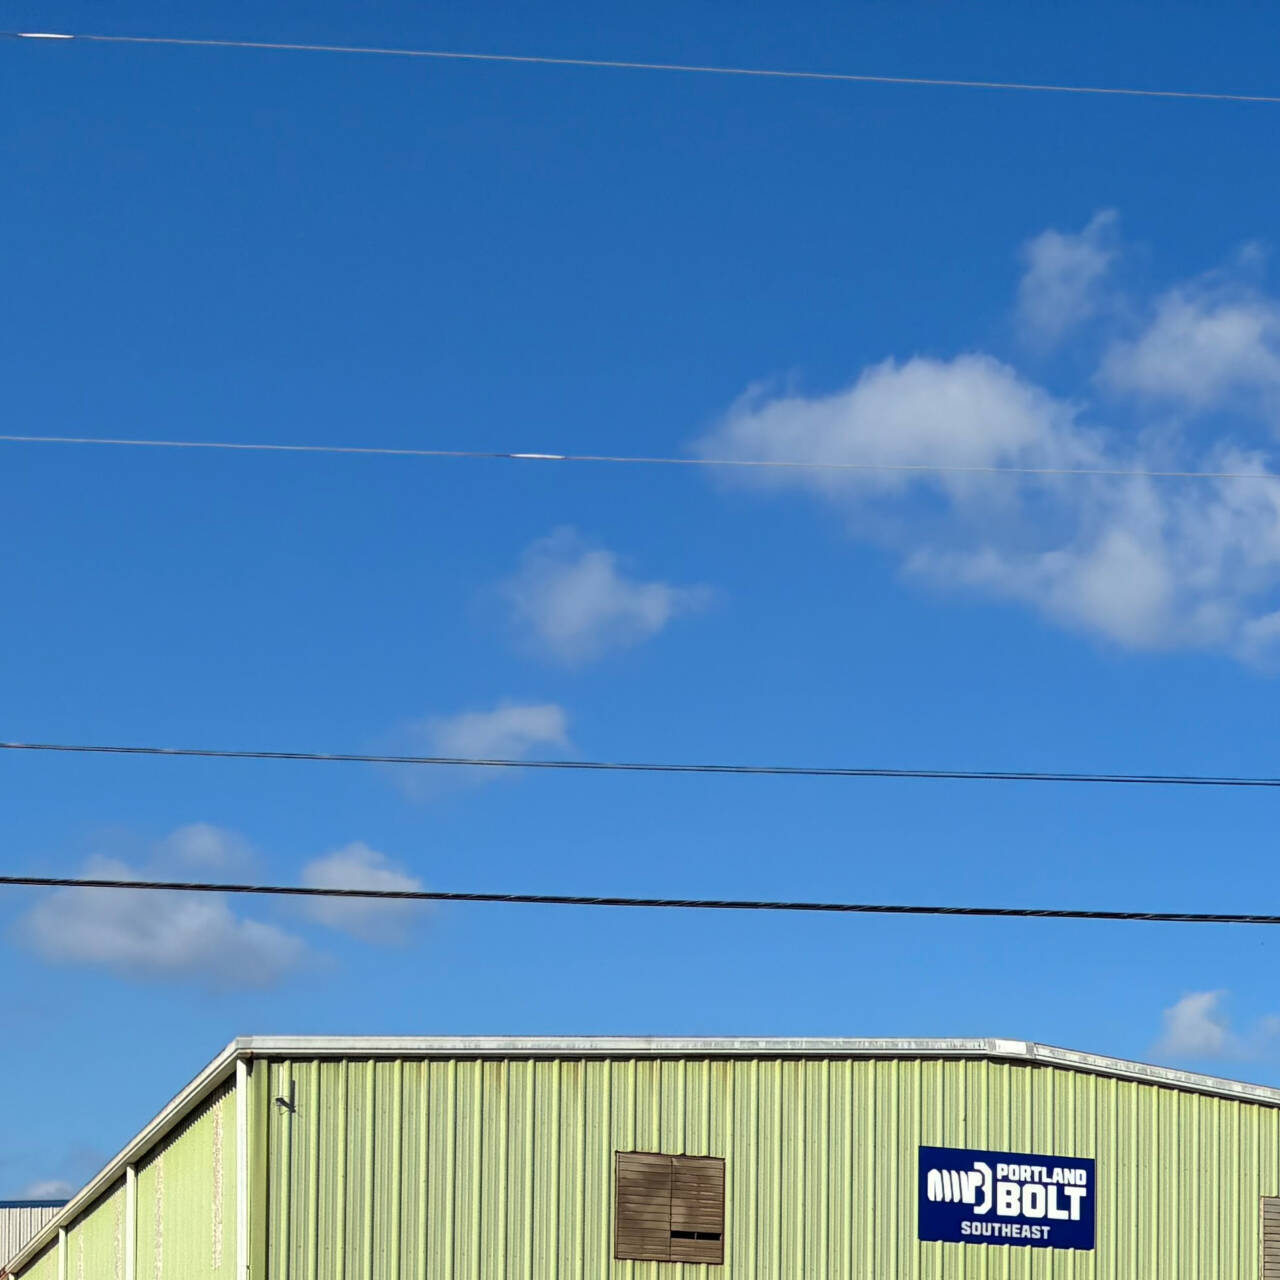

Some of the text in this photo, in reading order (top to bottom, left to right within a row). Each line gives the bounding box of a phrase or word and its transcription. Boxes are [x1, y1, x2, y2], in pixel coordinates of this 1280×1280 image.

[996, 1163, 1087, 1185] PORTLAND
[996, 1181, 1087, 1221] BOLT
[960, 1221, 1051, 1240] SOUTHEAST
